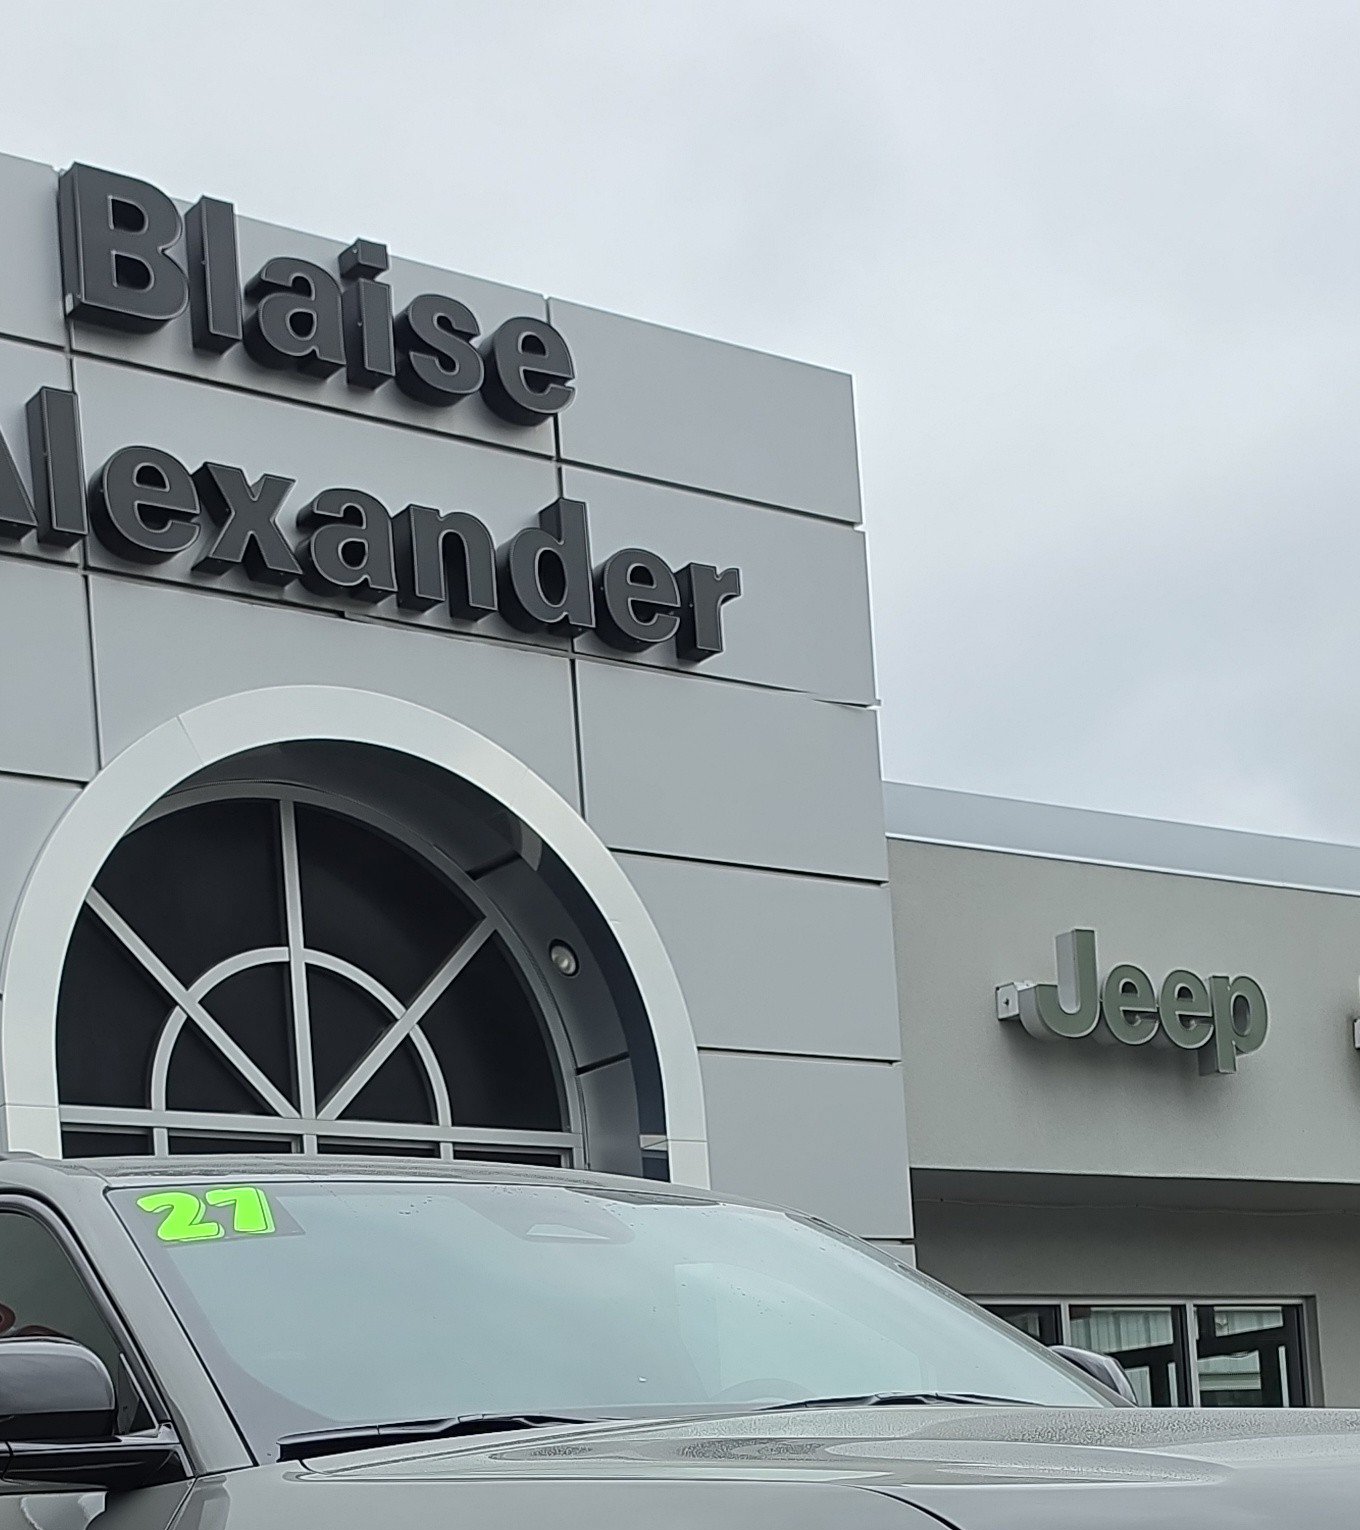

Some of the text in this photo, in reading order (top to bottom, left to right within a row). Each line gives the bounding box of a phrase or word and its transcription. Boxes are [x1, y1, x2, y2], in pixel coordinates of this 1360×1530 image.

[57, 162, 576, 426] Blaise
[1018, 926, 1268, 1075] Jeep
[137, 1187, 275, 1241] 27
